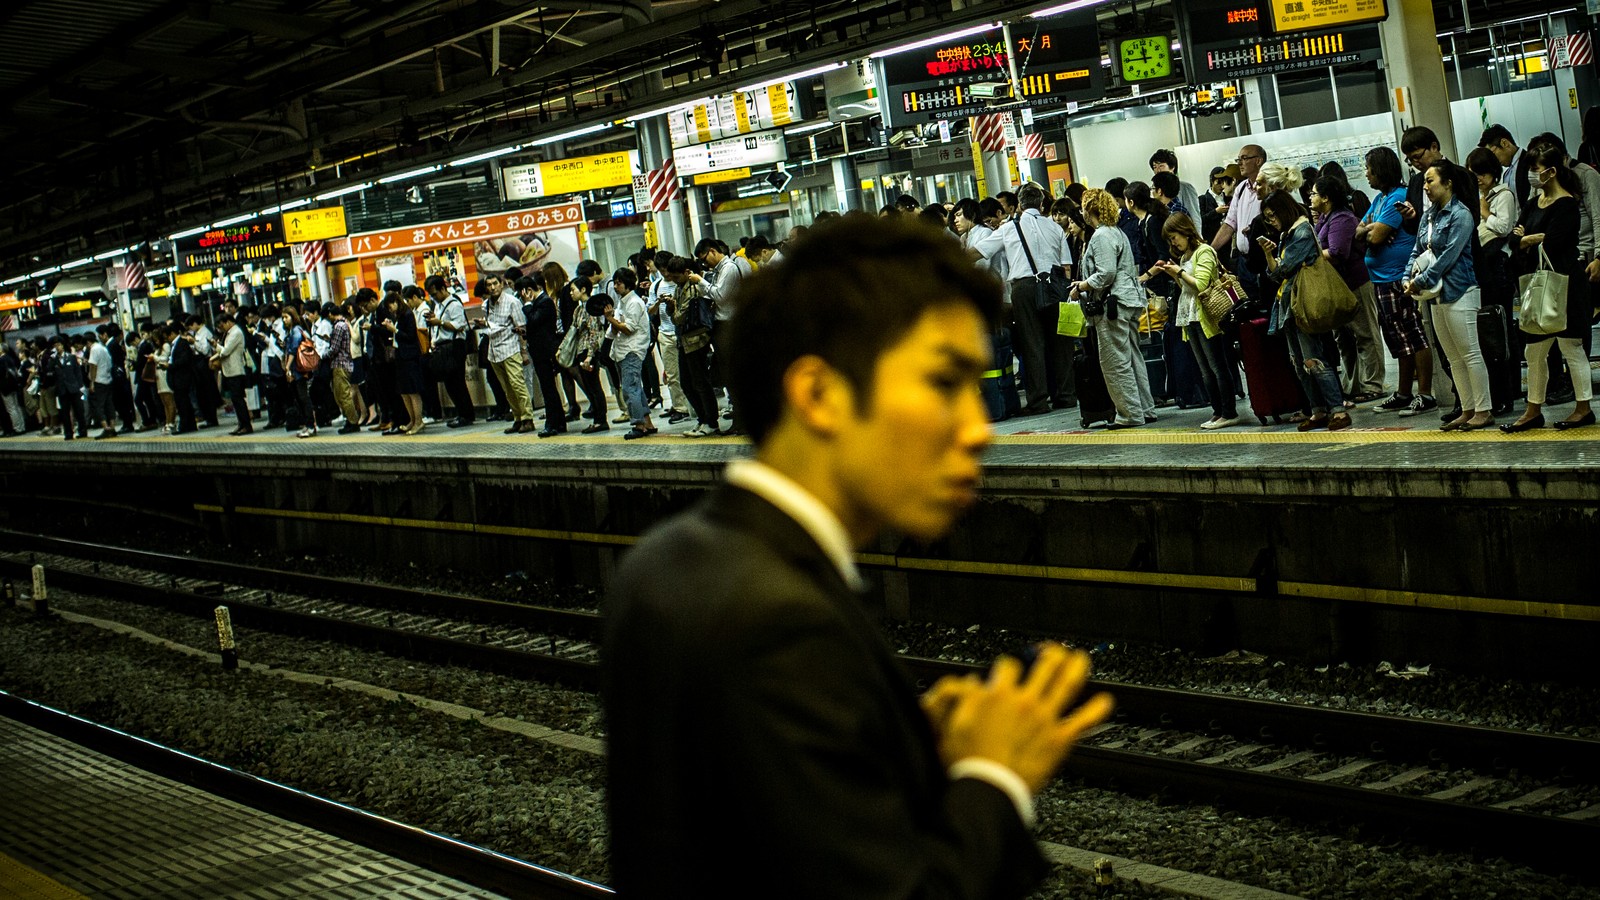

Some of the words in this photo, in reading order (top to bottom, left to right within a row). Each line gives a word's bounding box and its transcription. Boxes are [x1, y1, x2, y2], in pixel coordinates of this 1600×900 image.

[1284, 2, 1305, 14] 直進
[1291, 12, 1311, 21] straight
[936, 45, 972, 62] 中央特快
[938, 71, 1010, 87] 高尾までの停車
[553, 161, 584, 172] 中央西口
[594, 155, 624, 166] 中央東口
[357, 235, 392, 252] パン
[412, 219, 491, 244] おべんとう
[507, 206, 579, 230] おのみもの
